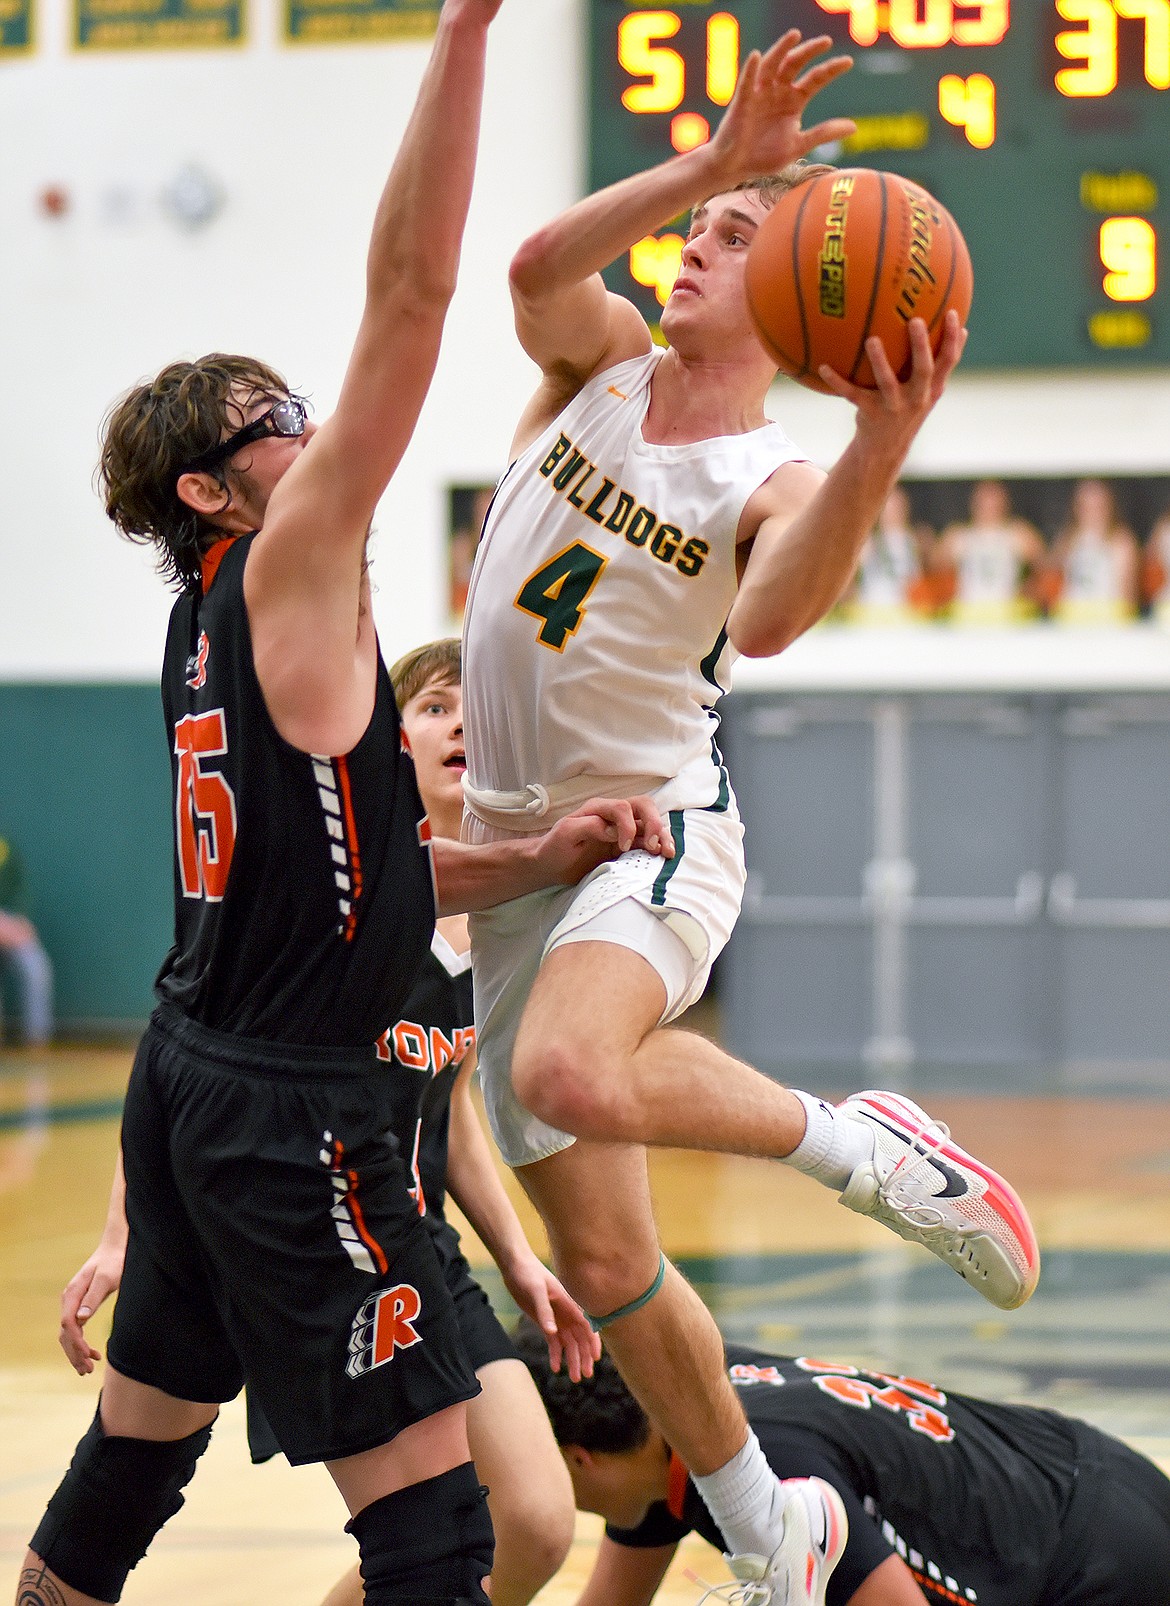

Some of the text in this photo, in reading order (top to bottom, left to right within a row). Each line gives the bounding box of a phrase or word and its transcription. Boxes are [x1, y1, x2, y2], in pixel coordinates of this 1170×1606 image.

[617, 10, 740, 113] 51
[1054, 0, 1170, 97] 37
[938, 73, 996, 149] 4
[1099, 216, 1157, 301] 9
[538, 431, 709, 578] BULLDOGS
[513, 539, 610, 654] 4
[174, 707, 237, 902] 15
[371, 1283, 423, 1369] R
